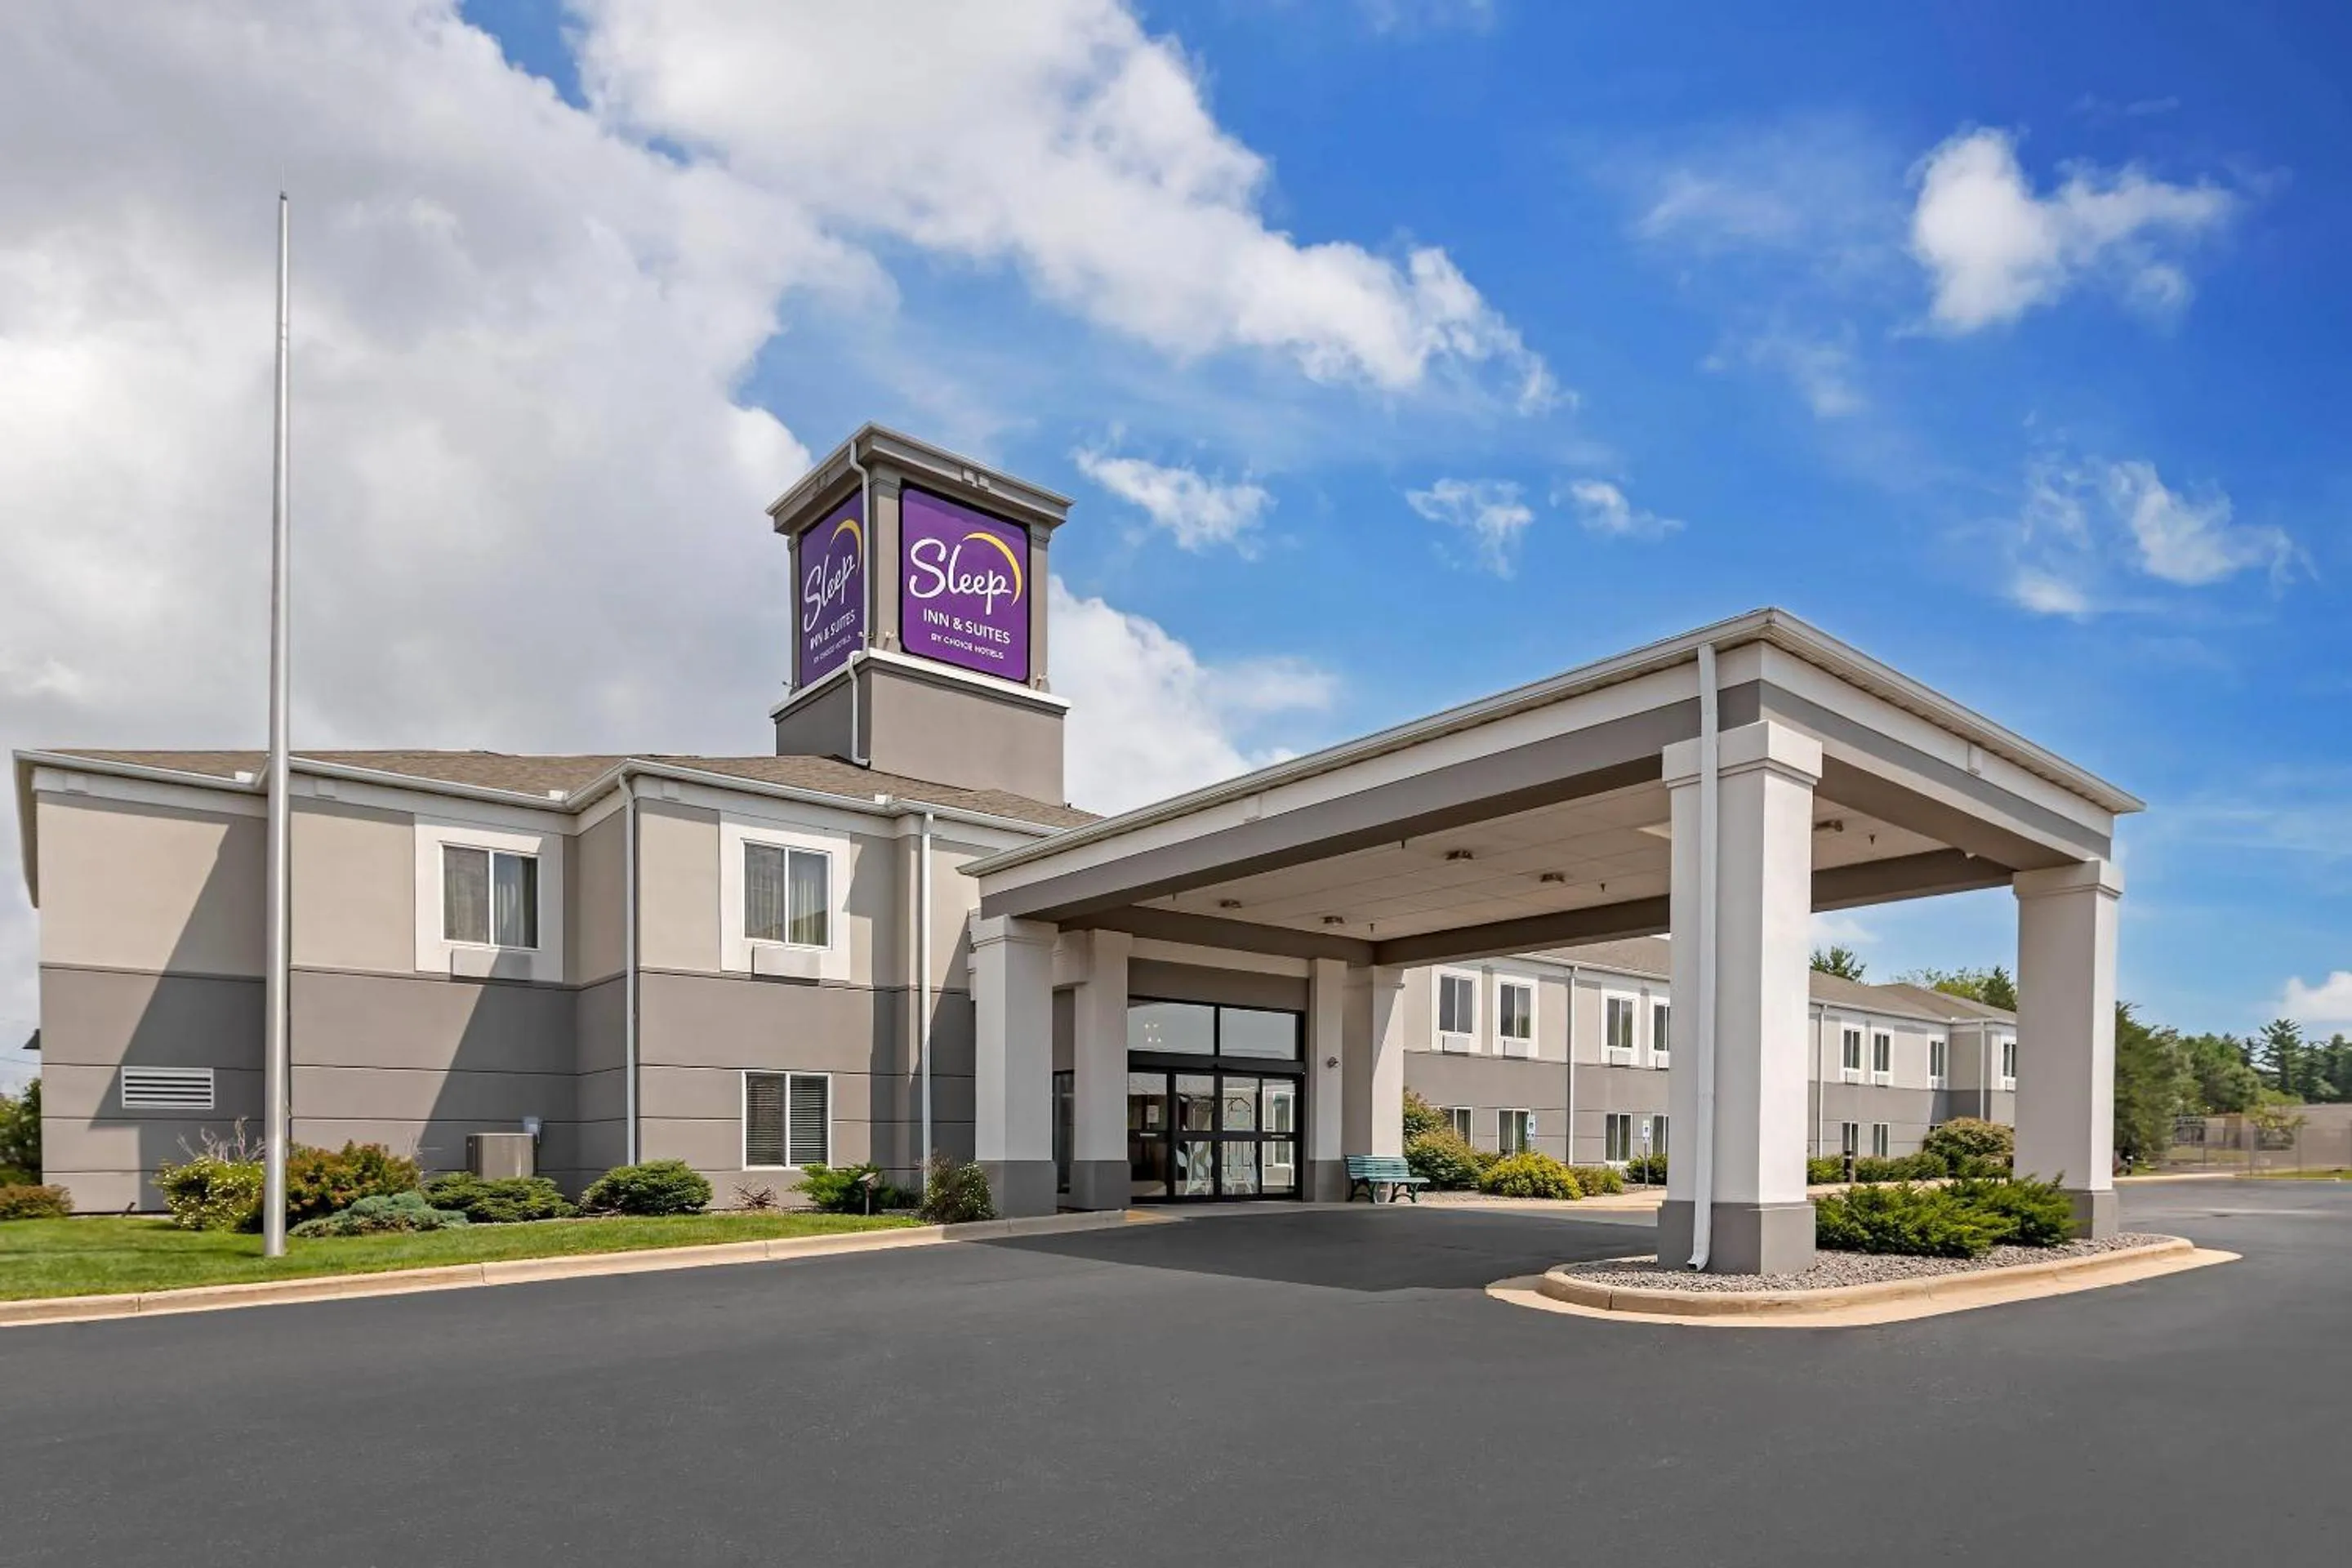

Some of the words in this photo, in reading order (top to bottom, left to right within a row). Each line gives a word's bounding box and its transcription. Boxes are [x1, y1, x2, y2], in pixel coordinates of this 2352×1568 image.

[804, 555, 856, 632] Sleep
[909, 538, 1012, 615] Sleep
[924, 608, 949, 627] INN
[953, 617, 964, 631] &
[965, 621, 1011, 644] SUITES
[931, 633, 942, 642] BY
[943, 636, 973, 651] CHOICE
